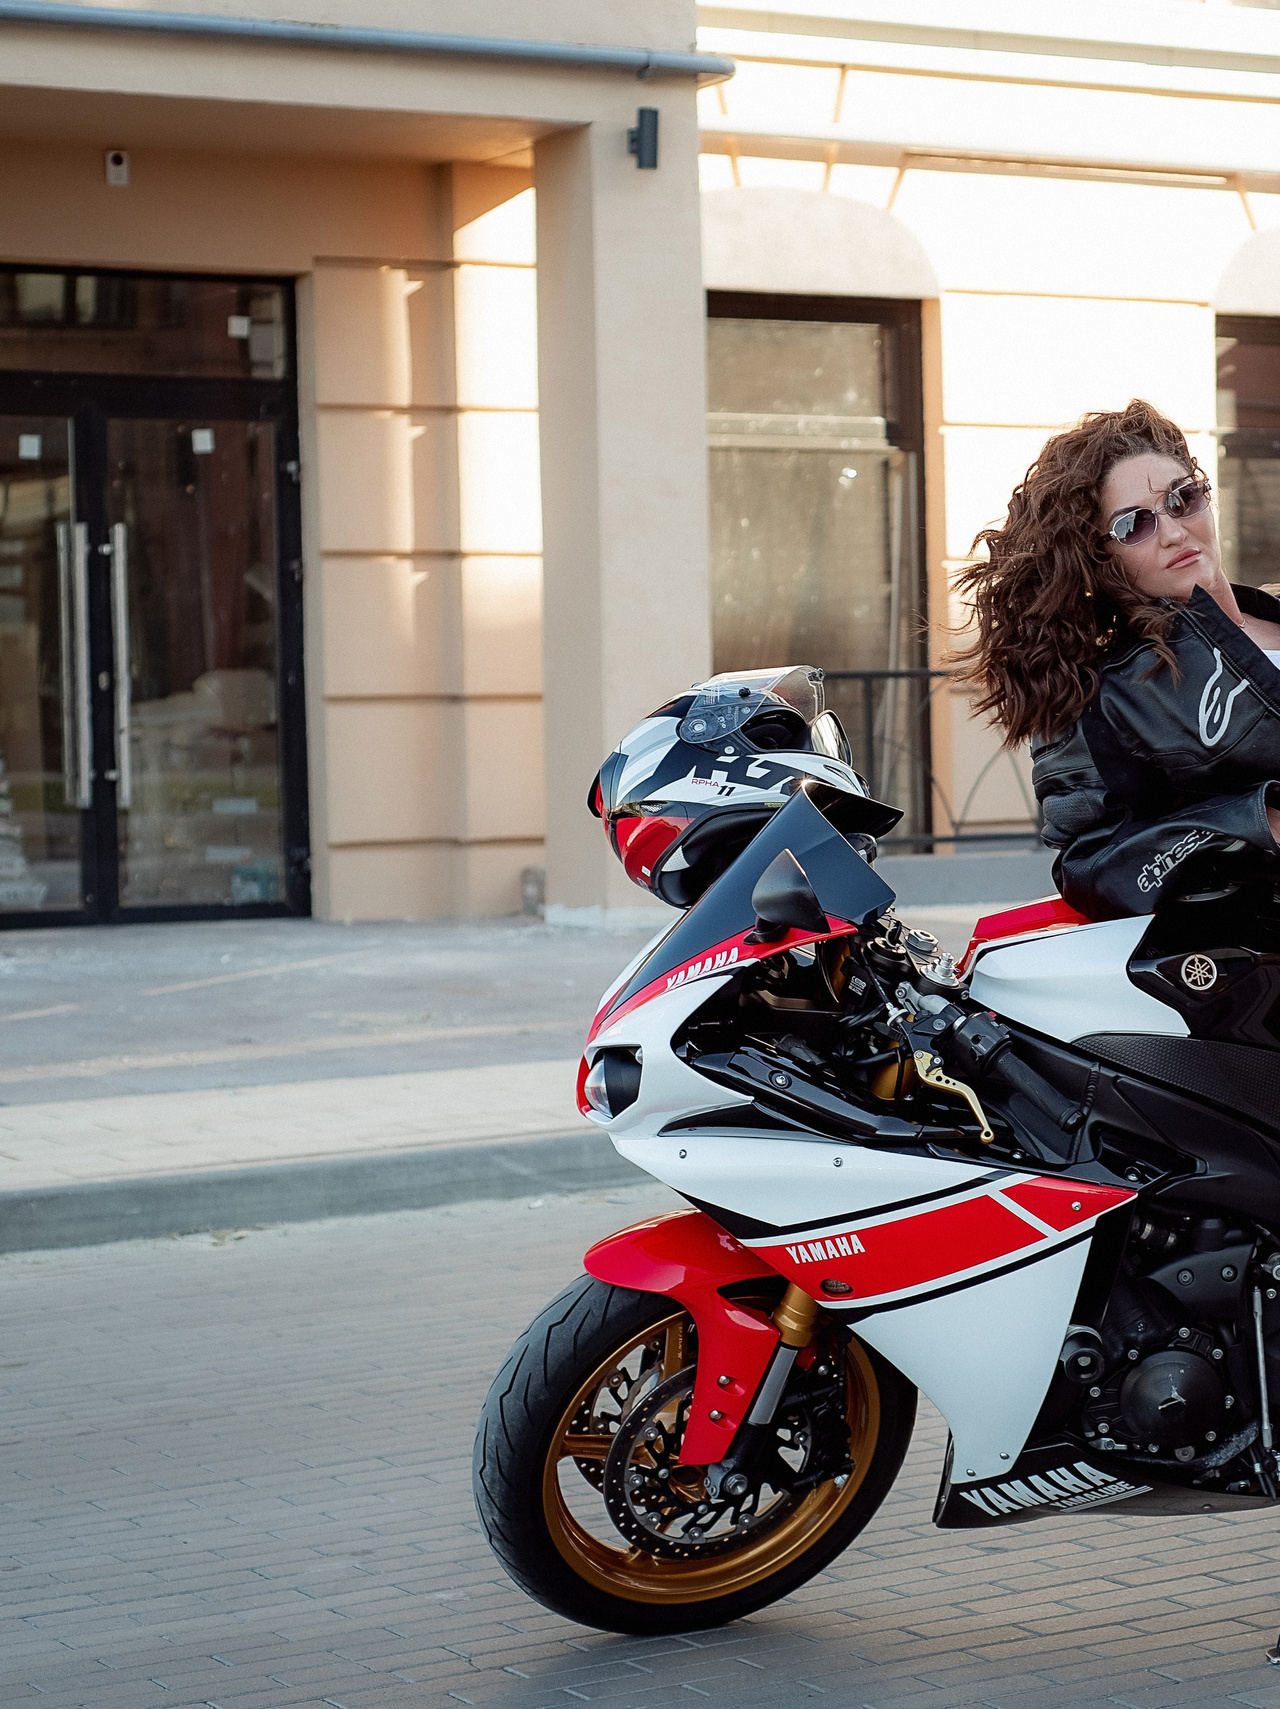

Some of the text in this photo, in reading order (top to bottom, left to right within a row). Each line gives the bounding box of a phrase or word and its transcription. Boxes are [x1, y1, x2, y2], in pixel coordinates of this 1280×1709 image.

[691, 778, 720, 788] RPHA
[717, 785, 736, 797] 11
[1137, 829, 1215, 893] alpines
[665, 947, 740, 989] YAMAHA
[785, 1234, 866, 1264] YAMAHA
[959, 1461, 1118, 1517] YAMAHA
[1049, 1480, 1136, 1508] YAMALUBE
